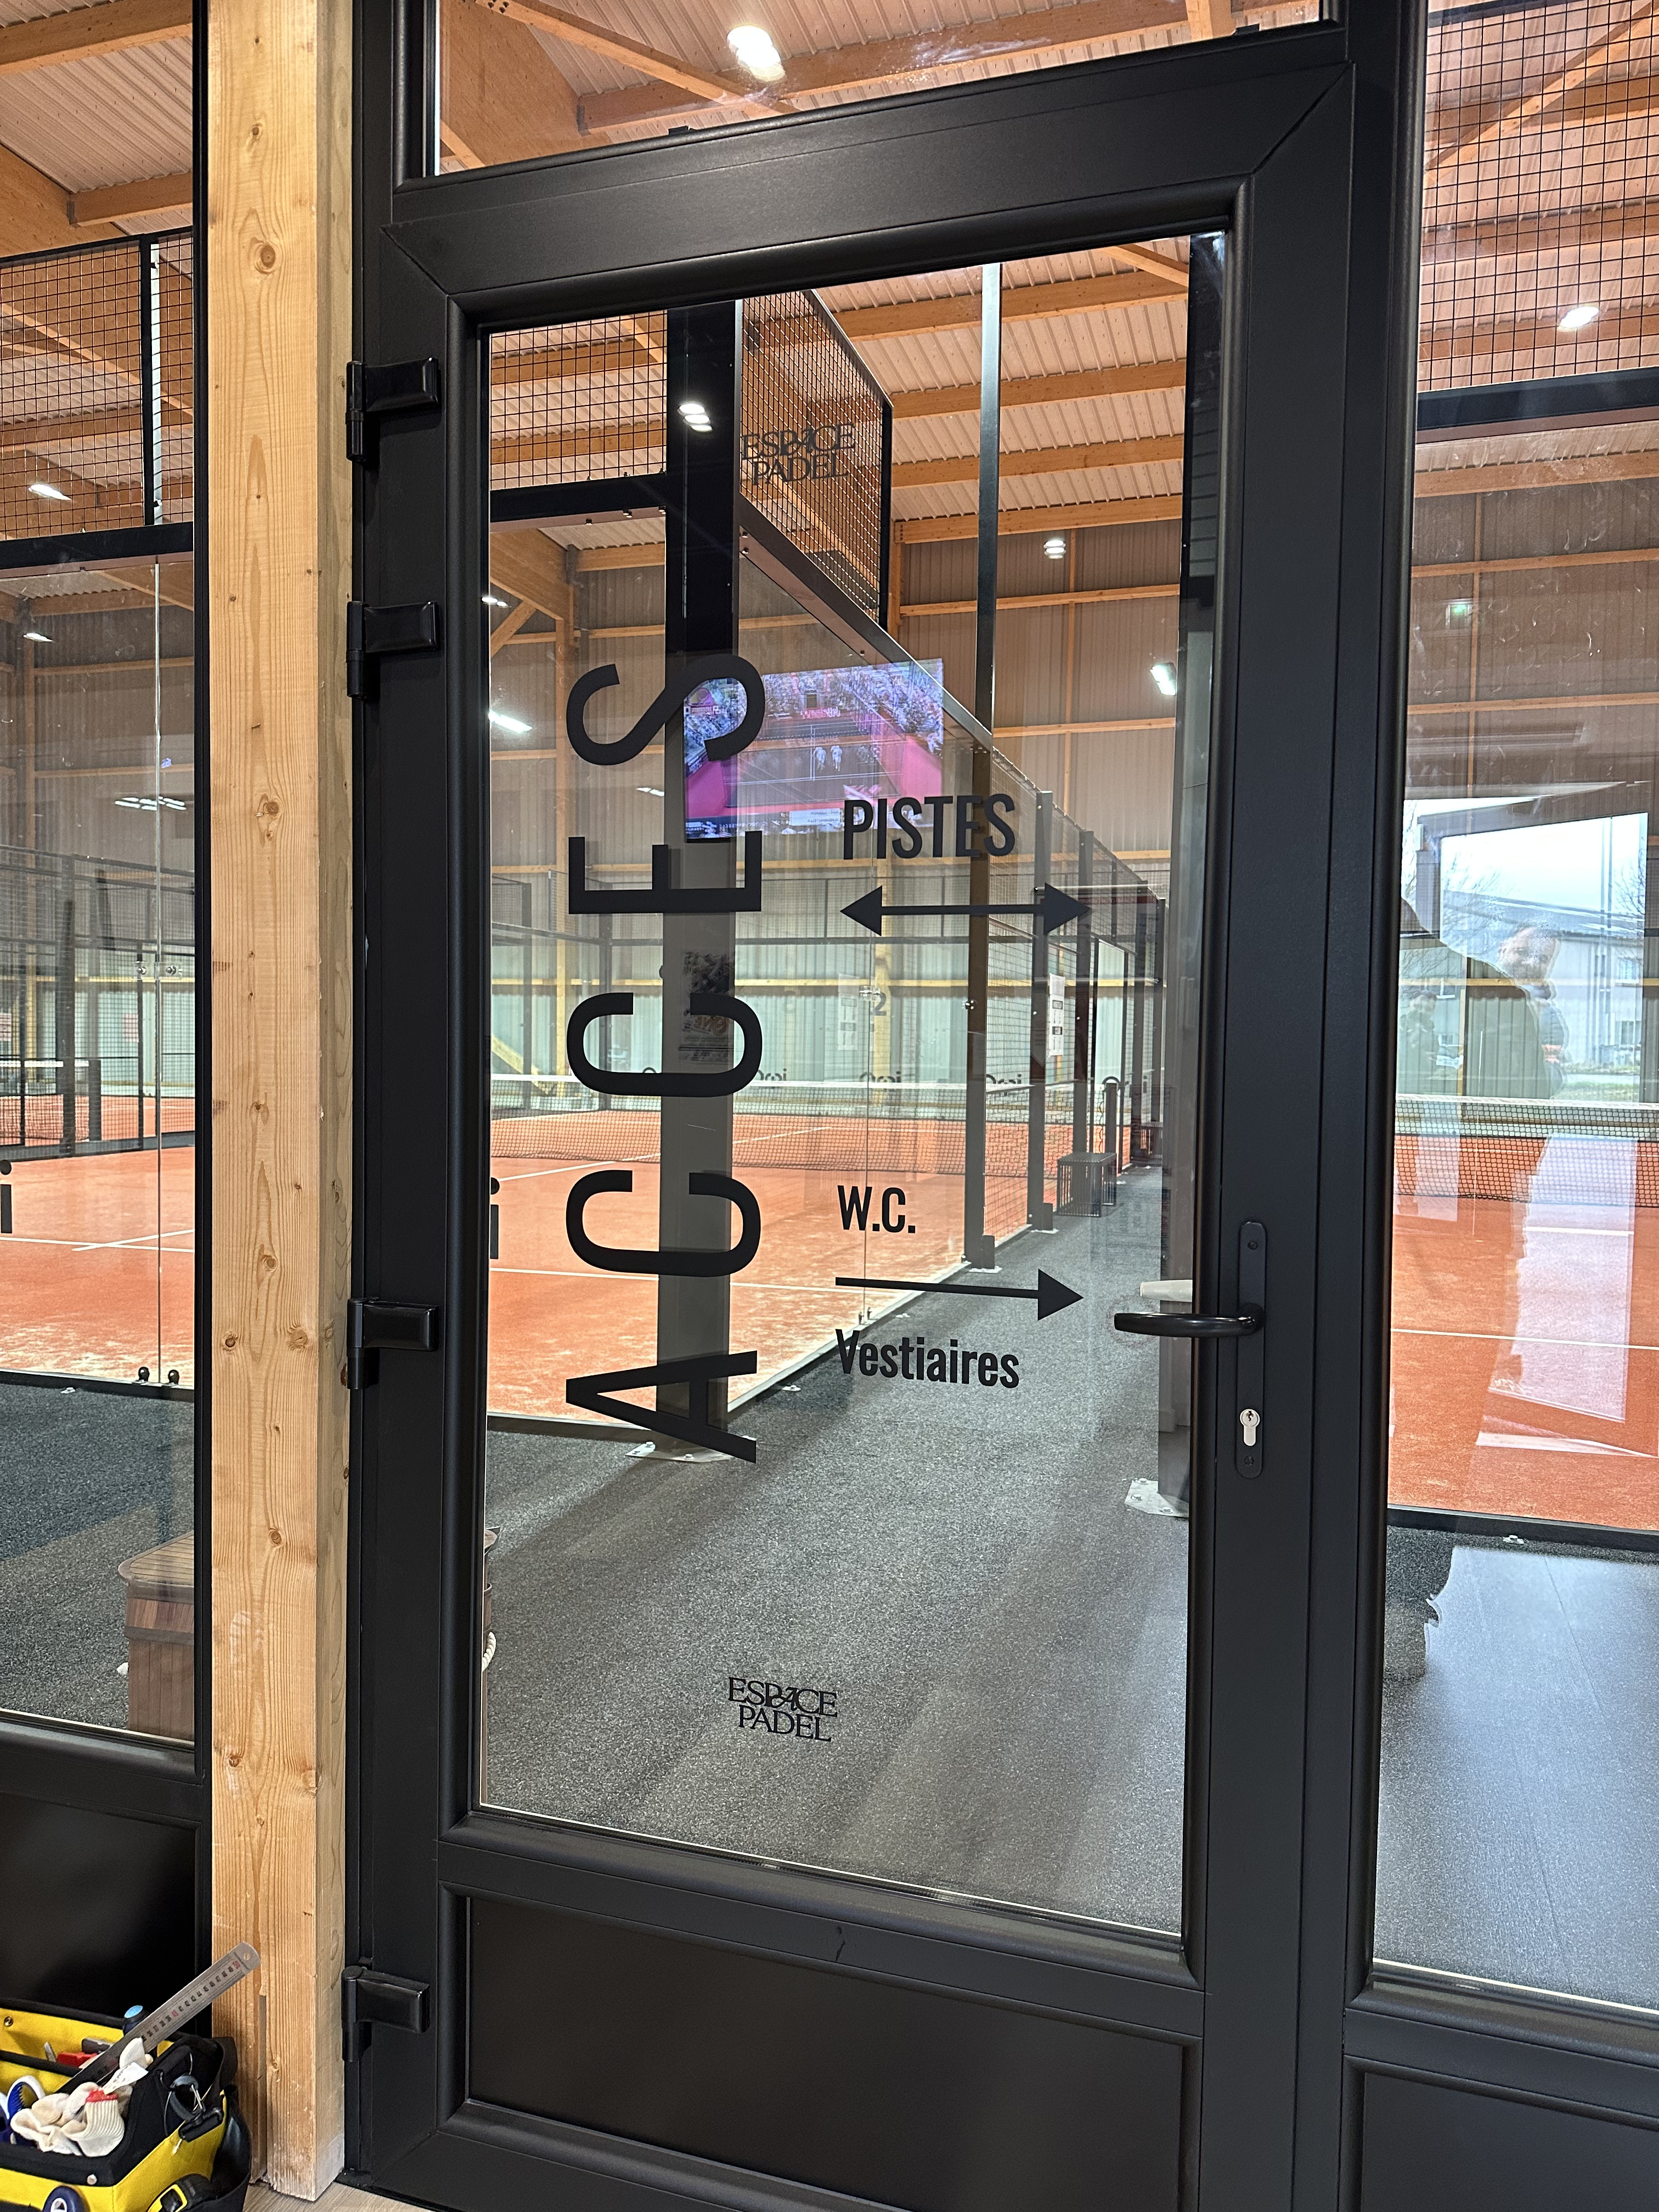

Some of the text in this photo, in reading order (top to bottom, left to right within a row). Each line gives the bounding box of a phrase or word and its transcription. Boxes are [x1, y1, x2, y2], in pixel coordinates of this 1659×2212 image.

[742, 423, 855, 460] ESPACE
[752, 451, 849, 486] PADEL
[843, 793, 1016, 860] PISTES
[566, 653, 766, 1464] ACCES
[837, 1185, 916, 1234] W.C.
[835, 1328, 1020, 1389] Vestiaires
[727, 1677, 838, 1718] ESPACE
[738, 1704, 832, 1742] PADEL
